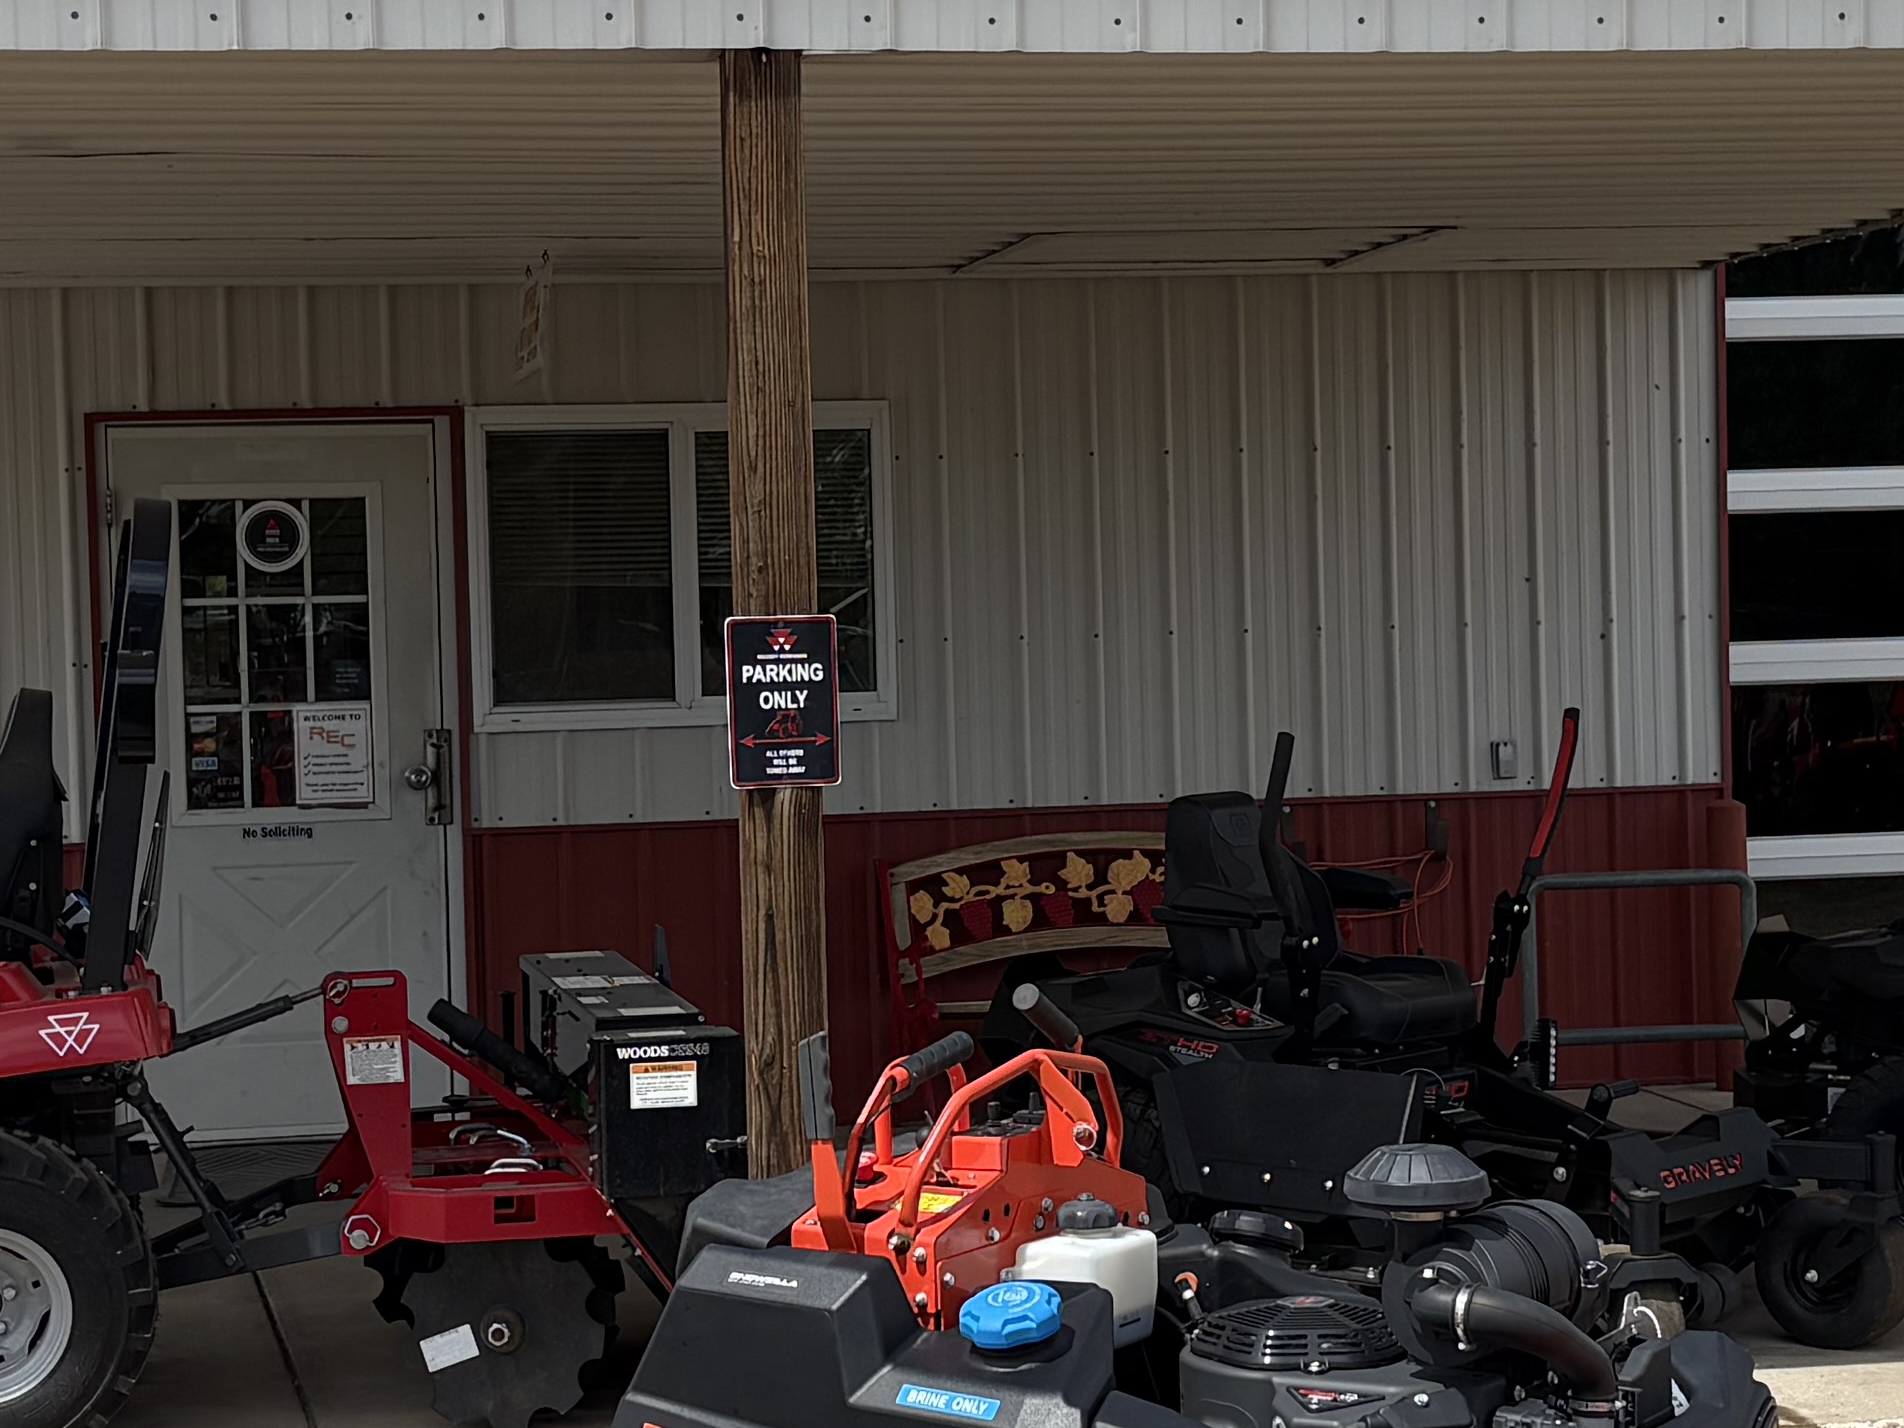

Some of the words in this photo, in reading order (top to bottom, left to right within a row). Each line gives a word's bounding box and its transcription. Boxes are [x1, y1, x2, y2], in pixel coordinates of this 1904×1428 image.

[742, 663, 824, 683] PARKING
[759, 690, 808, 709] ONLY
[303, 714, 346, 722] WELCOME
[348, 713, 361, 721] TO
[309, 726, 356, 748] REC
[195, 759, 217, 768] VISA
[243, 828, 258, 839] No
[261, 826, 314, 839] Soliciting
[616, 1046, 669, 1060] WOODS
[1169, 1045, 1214, 1059] STEALTH
[1660, 1153, 1743, 1189] GRAVELY
[907, 1389, 949, 1409] BRINE
[951, 1398, 989, 1415] ONLY
